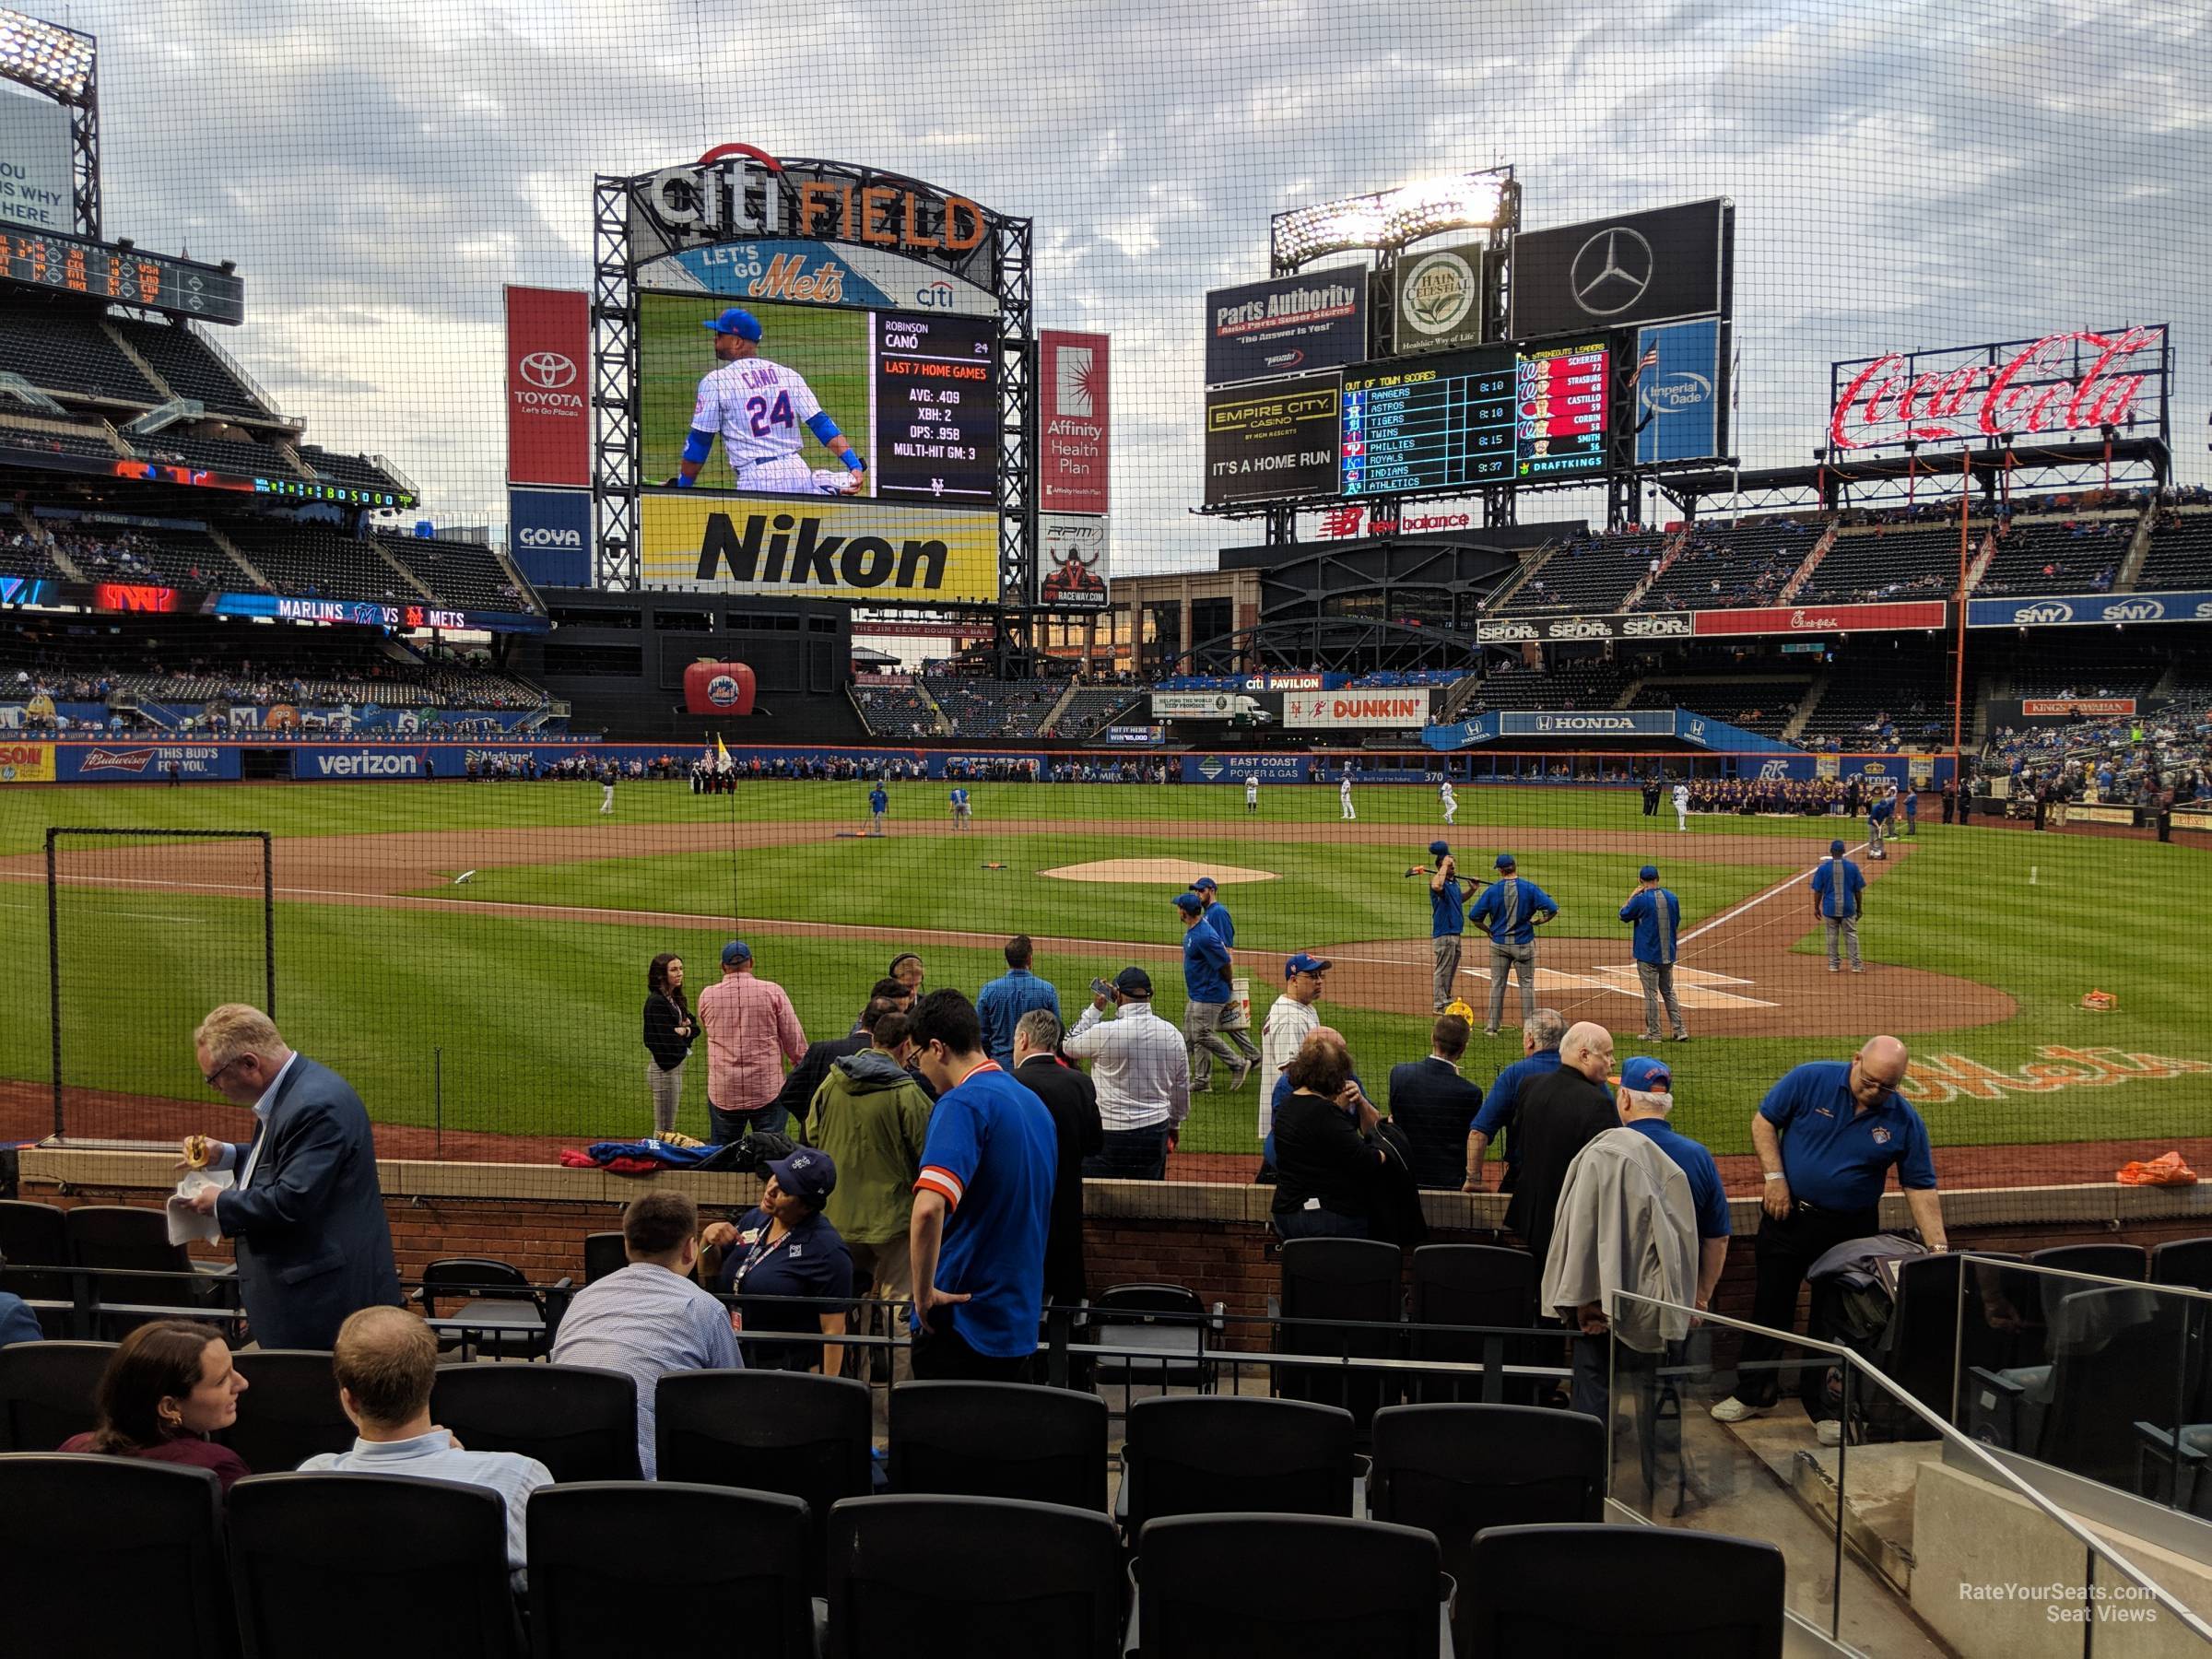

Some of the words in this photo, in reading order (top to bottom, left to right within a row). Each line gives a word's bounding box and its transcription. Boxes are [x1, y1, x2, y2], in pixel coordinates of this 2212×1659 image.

[21, 185, 62, 206] WHY
[651, 159, 779, 231] citi
[802, 181, 984, 250] FIELD
[2, 201, 55, 225] HERE.
[35, 235, 108, 256] NATIONAL
[117, 251, 171, 268] LEAGUE
[702, 244, 759, 265] LET'S
[735, 262, 762, 278] GO
[748, 253, 844, 303] Mets
[1422, 273, 1455, 285] HAIN
[916, 285, 953, 308] citi
[1406, 279, 1472, 300] CELESTIAL
[1218, 300, 1264, 326] Parts
[1267, 285, 1355, 319] Authority
[886, 320, 928, 334] ROBINSON
[1222, 324, 1245, 335] Auto
[1248, 319, 1277, 330] Parts
[1278, 314, 1311, 325] Super
[1312, 307, 1350, 318] Stores
[1260, 328, 1296, 341] Answer
[1298, 326, 1307, 335] Is
[1403, 339, 1434, 350] Healthier
[1435, 337, 1449, 346] Way
[1460, 332, 1475, 341] Life
[886, 334, 919, 349] CANÓ
[974, 343, 988, 353] 24
[1575, 344, 1605, 353] LEADERS
[1569, 354, 1602, 366] SCHERZER
[886, 361, 912, 374] LAST
[914, 363, 920, 374] 7
[922, 364, 951, 377] HOME
[953, 367, 987, 380] GAMES
[1345, 381, 1360, 391] OUT
[1364, 379, 1376, 388] OF
[1380, 375, 1401, 386] TOWN
[1405, 371, 1436, 383] SCORES
[1568, 374, 1602, 385] STRASBURG
[1371, 388, 1410, 400] RANGERS
[1651, 382, 1698, 397] Imperial
[1830, 325, 2165, 450] Coca-Cola
[514, 391, 583, 407] TOYOTA
[910, 388, 934, 402] AVG:
[936, 391, 960, 404] .409
[1568, 394, 1601, 405] CASTILLO
[1670, 393, 1701, 406] Dade
[522, 406, 540, 414] Let's
[553, 408, 579, 417] Places
[747, 389, 794, 438] 24
[918, 407, 942, 421] XBH:
[945, 409, 952, 422] 2
[1216, 405, 1283, 423] EMPIRE
[1288, 398, 1328, 414] CITY
[1371, 401, 1405, 413] ASTROS
[1251, 417, 1292, 429] CASINO
[1371, 415, 1405, 426] TIGERS
[1574, 414, 1601, 424] CORBIN
[910, 426, 934, 440] OPS:
[1047, 420, 1102, 441] Affinity
[1269, 429, 1297, 438] RESORTS
[1371, 429, 1398, 439] TWINS
[1371, 440, 1415, 452] PHILLIES
[1578, 434, 1600, 443] SMITH
[894, 442, 945, 458] MULTI-HIT
[947, 447, 966, 460] GM:
[969, 448, 975, 460] 3
[1052, 440, 1099, 456] Health
[1060, 458, 1089, 475] Plan
[1213, 461, 1238, 477] IT'S
[1241, 459, 1251, 473] A
[1254, 453, 1297, 472] HOME
[1300, 450, 1331, 466] RUN
[1370, 453, 1404, 465] ROYALS
[1534, 457, 1602, 472] DRAFTKINGS
[1371, 465, 1408, 477] INDIANS
[1053, 487, 1073, 495] Affinity
[1370, 477, 1420, 490] ATHLETICS
[399, 495, 413, 503] TOP
[1048, 525, 1092, 537] RPM
[1368, 520, 1399, 534] new
[1403, 513, 1470, 531] balance
[520, 528, 581, 546] GOYA
[696, 512, 948, 589] Nikon
[1044, 590, 1104, 602] RPMRACEWAY.COM
[279, 600, 344, 619] MARLINS
[382, 606, 398, 623] VS
[429, 610, 465, 628] METS
[1246, 676, 1264, 689] citi
[1270, 677, 1319, 689] PAVILION
[1334, 699, 1420, 718] DUNKIN'
[1555, 717, 1636, 729] HONDA
[1461, 733, 1490, 744] HONDA
[1684, 732, 1706, 745] HONDA
[88, 751, 148, 766] Budweiser
[158, 747, 182, 759] THIS
[186, 747, 218, 759] BUD'S
[182, 760, 207, 772] YOU.
[318, 749, 417, 774] verizon
[1230, 758, 1258, 767] EAST
[1261, 758, 1299, 767] COAST
[1230, 769, 1267, 778] POWER
[1269, 769, 1276, 778] &
[1277, 769, 1299, 778] GAS
[1425, 771, 1443, 782] 370
